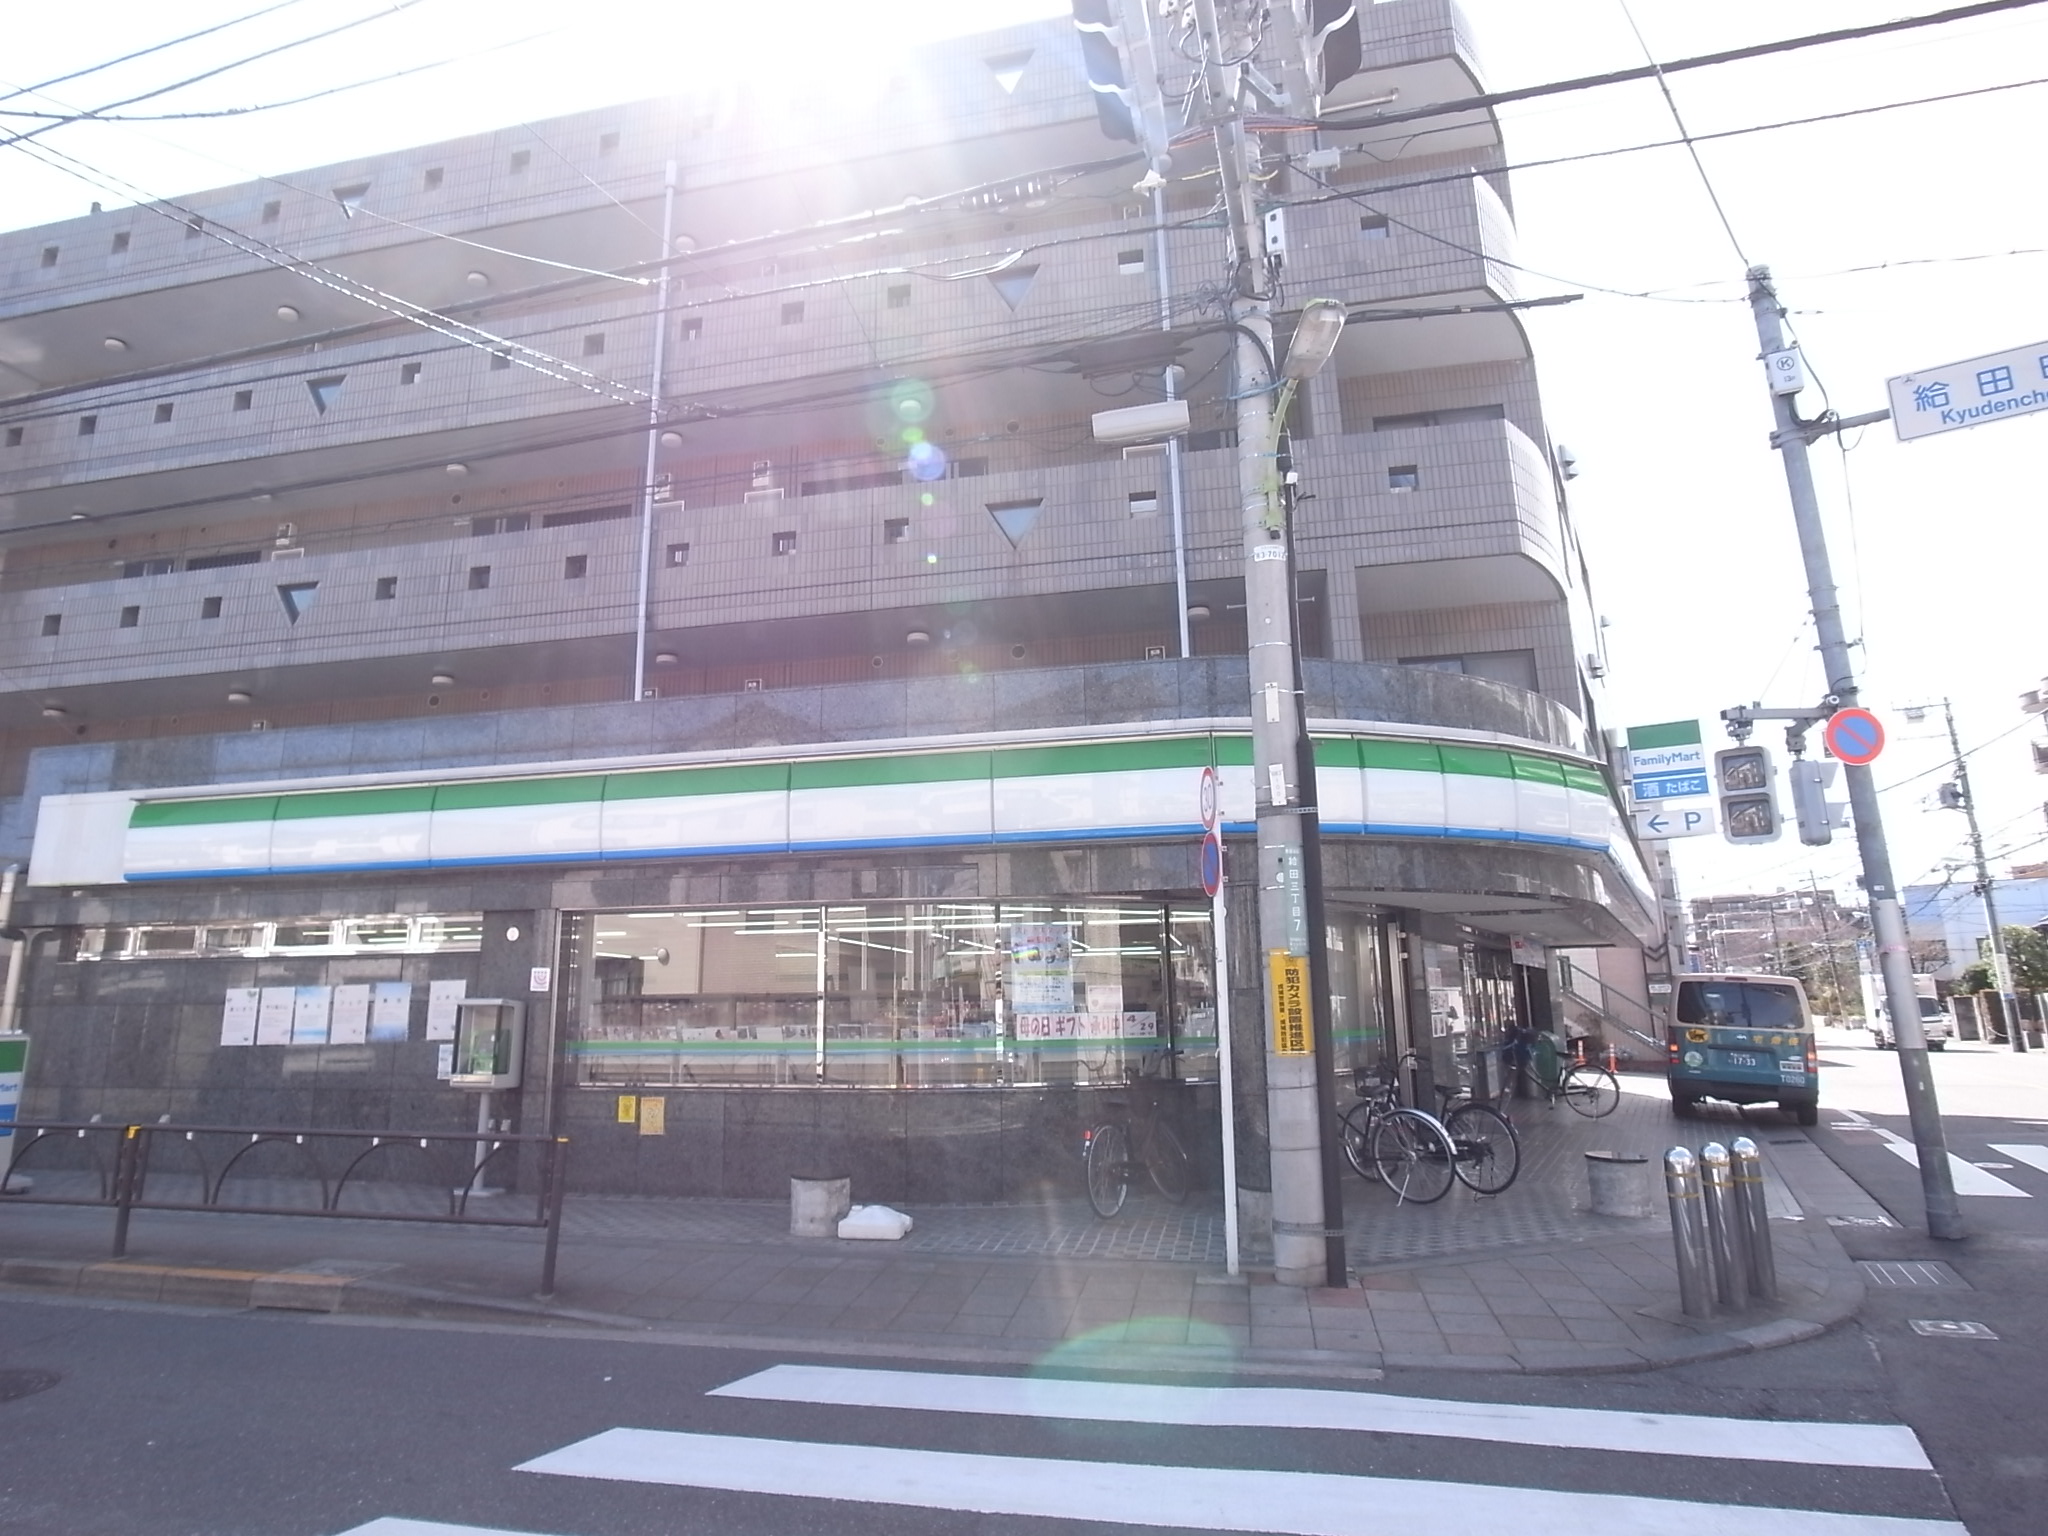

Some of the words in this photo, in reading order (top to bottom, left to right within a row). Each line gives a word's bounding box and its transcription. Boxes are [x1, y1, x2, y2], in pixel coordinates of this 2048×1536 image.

[1941, 389, 2048, 425] Kyudench
[1633, 750, 1701, 767] FamilyMart
[1202, 783, 1212, 813] 30
[1643, 783, 1660, 798] 酒
[1666, 780, 1702, 793] たばこ
[1684, 811, 1702, 831] P
